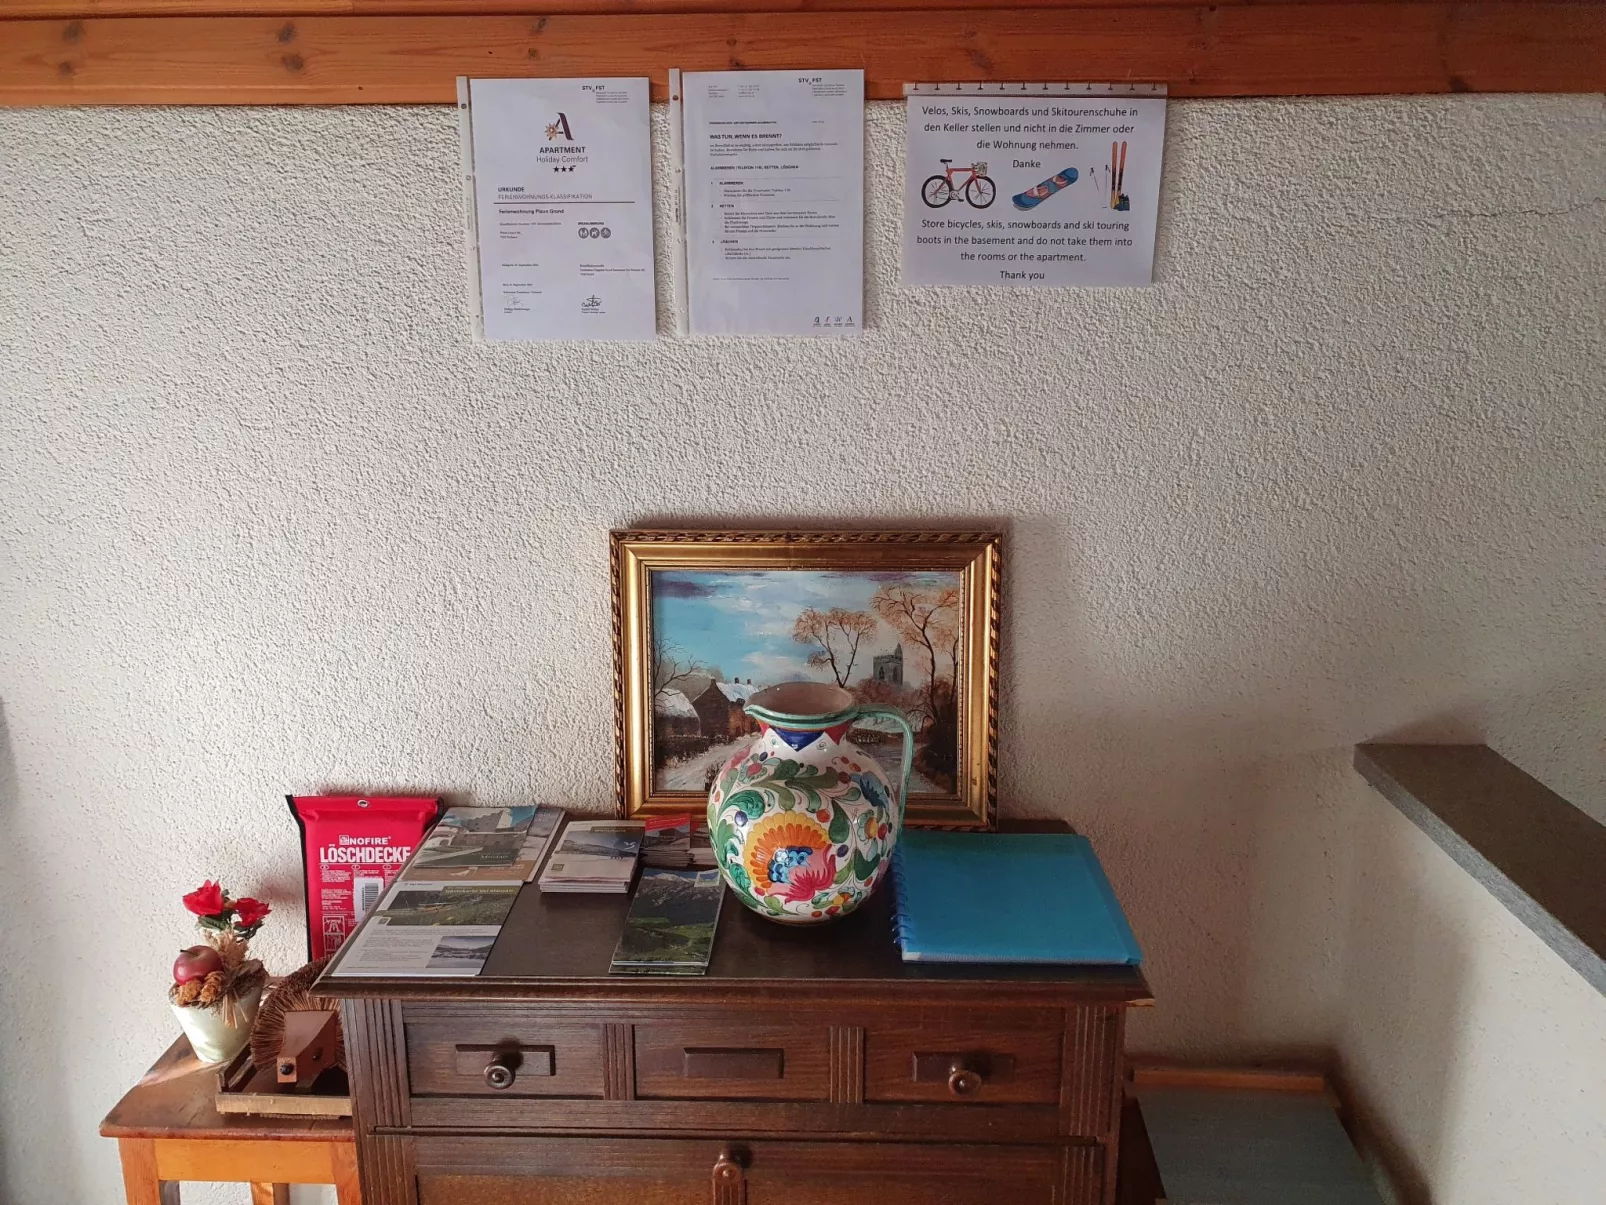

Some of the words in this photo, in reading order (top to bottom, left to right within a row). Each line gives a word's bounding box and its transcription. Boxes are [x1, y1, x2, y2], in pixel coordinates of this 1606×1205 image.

[922, 106, 949, 117] Velos,
[951, 107, 971, 117] Skis,
[974, 107, 1029, 116] Snowboards
[1032, 107, 1048, 116] und
[1052, 107, 1127, 116] Skitourenschuhe
[1130, 107, 1138, 116] in
[924, 123, 941, 133] den
[944, 123, 969, 133] Keller
[971, 123, 1001, 133] stellen
[1004, 123, 1021, 133] und
[1024, 124, 1046, 133] nicht
[1049, 124, 1057, 133] in
[1059, 124, 1073, 133] die
[1075, 124, 1110, 133] Zimmer
[1113, 124, 1134, 133] oder
[977, 140, 990, 149] die
[993, 140, 1037, 151] Wohnung
[1039, 141, 1079, 150] nehmen.
[1013, 160, 1041, 168] Danke
[922, 220, 945, 229] Store
[948, 220, 984, 231] bicycles,
[987, 220, 1005, 231] skis,
[1008, 220, 1061, 230] snowboards
[1064, 221, 1080, 230] and
[1083, 221, 1094, 230] ski
[1097, 221, 1129, 232] touring
[917, 236, 941, 245] boots
[944, 236, 952, 245] in
[954, 236, 969, 245] the
[972, 236, 1015, 246] basement
[1018, 237, 1034, 246] and
[1036, 237, 1047, 246] do
[1050, 237, 1065, 246] not
[1067, 237, 1086, 246] take
[1089, 237, 1112, 246] them
[1115, 237, 1132, 246] into
[961, 252, 975, 261] the
[1019, 252, 1034, 261] the
[1037, 253, 1085, 264] apartment.
[1000, 271, 1026, 280] Thank
[1029, 272, 1045, 282] you
[350, 837, 388, 845] NOFIRE
